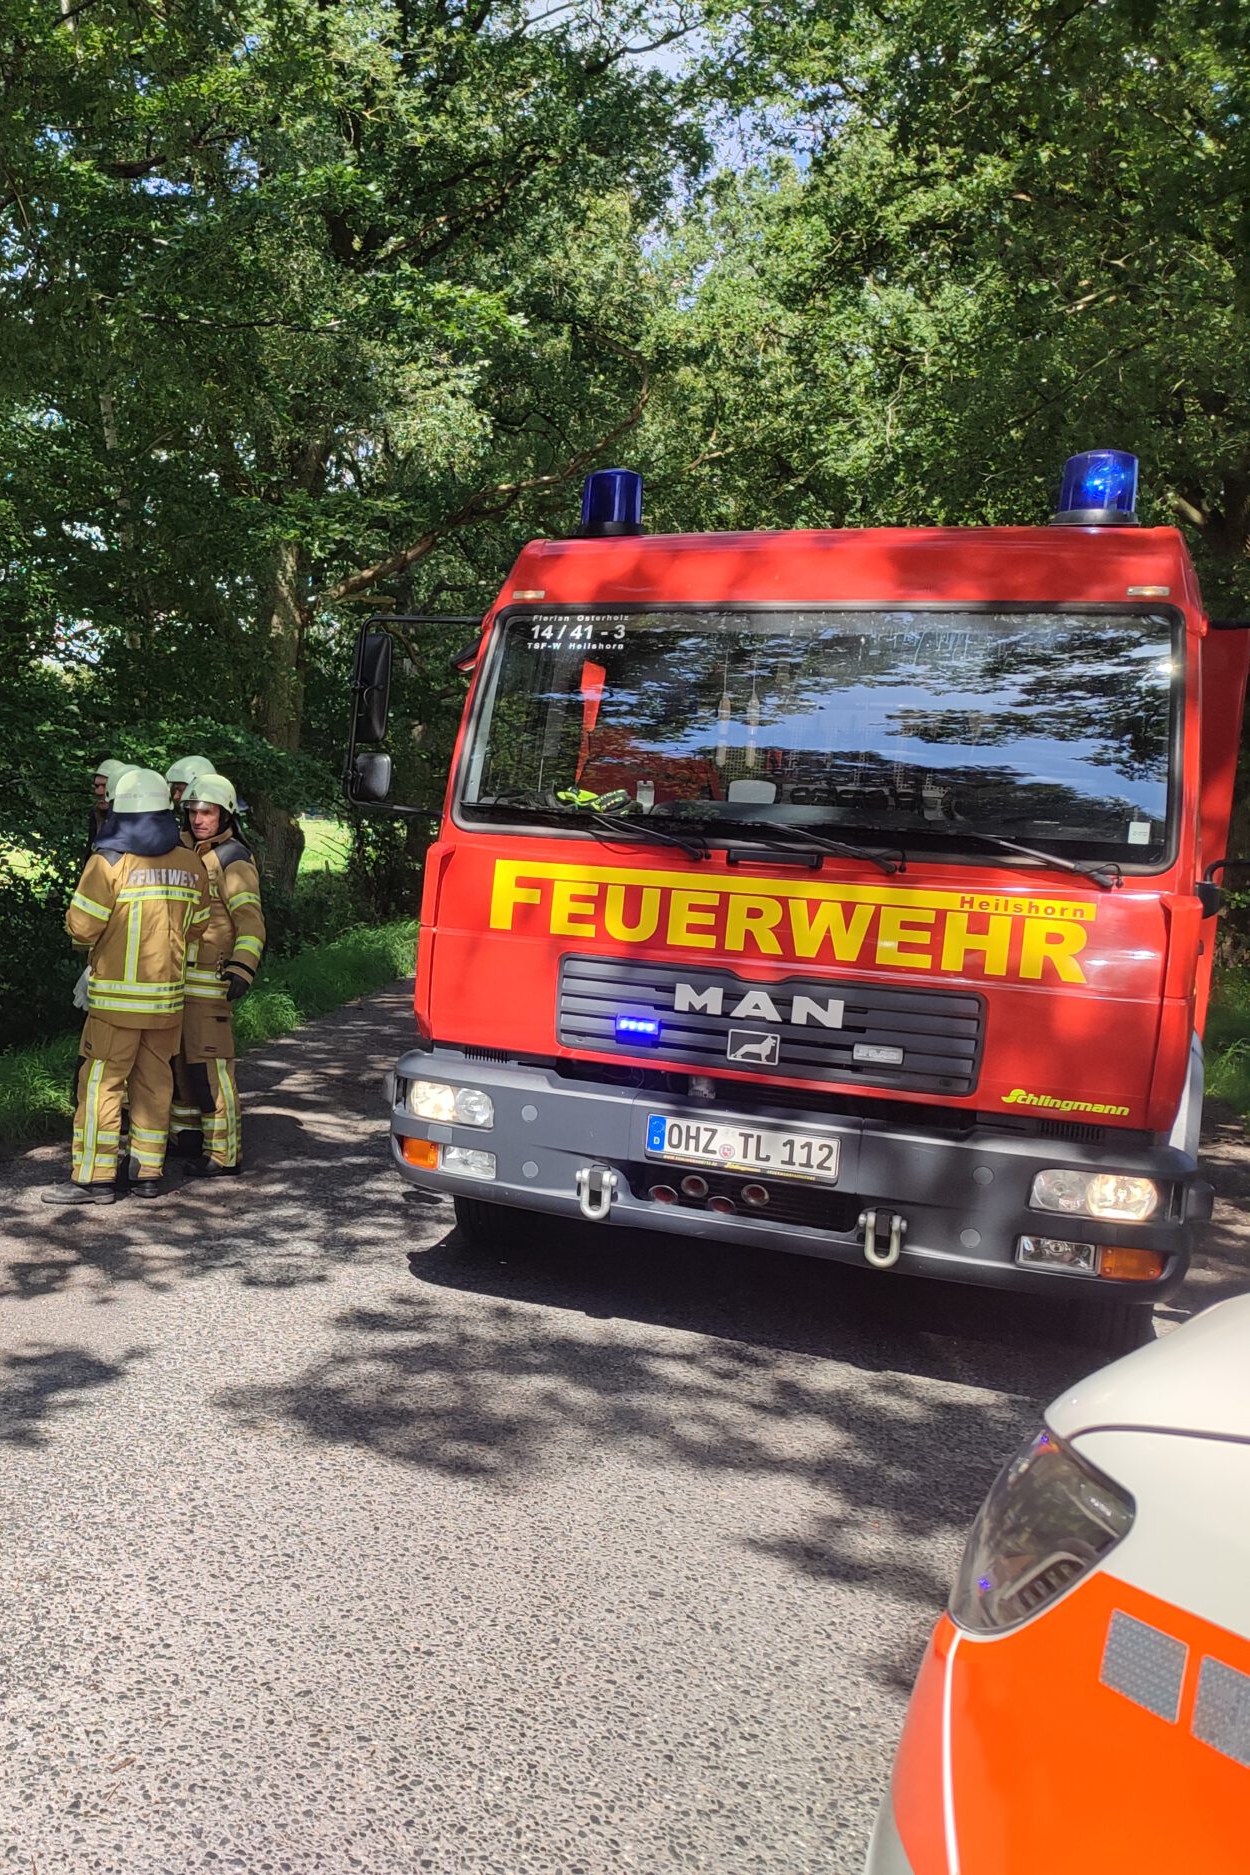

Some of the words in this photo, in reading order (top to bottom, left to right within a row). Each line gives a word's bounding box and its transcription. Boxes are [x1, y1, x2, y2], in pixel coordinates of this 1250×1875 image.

[526, 642, 562, 650] TSF-W
[568, 642, 625, 650] Heilshorn
[959, 895, 1085, 919] Heilshorn
[489, 859, 1088, 984] FEUERWEHR
[674, 983, 845, 1029] MAN
[1000, 1088, 1130, 1116] Schlingmann
[653, 1136, 661, 1145] D
[667, 1123, 719, 1155] OHZ
[738, 1132, 771, 1162] TL
[780, 1138, 834, 1172] 112
